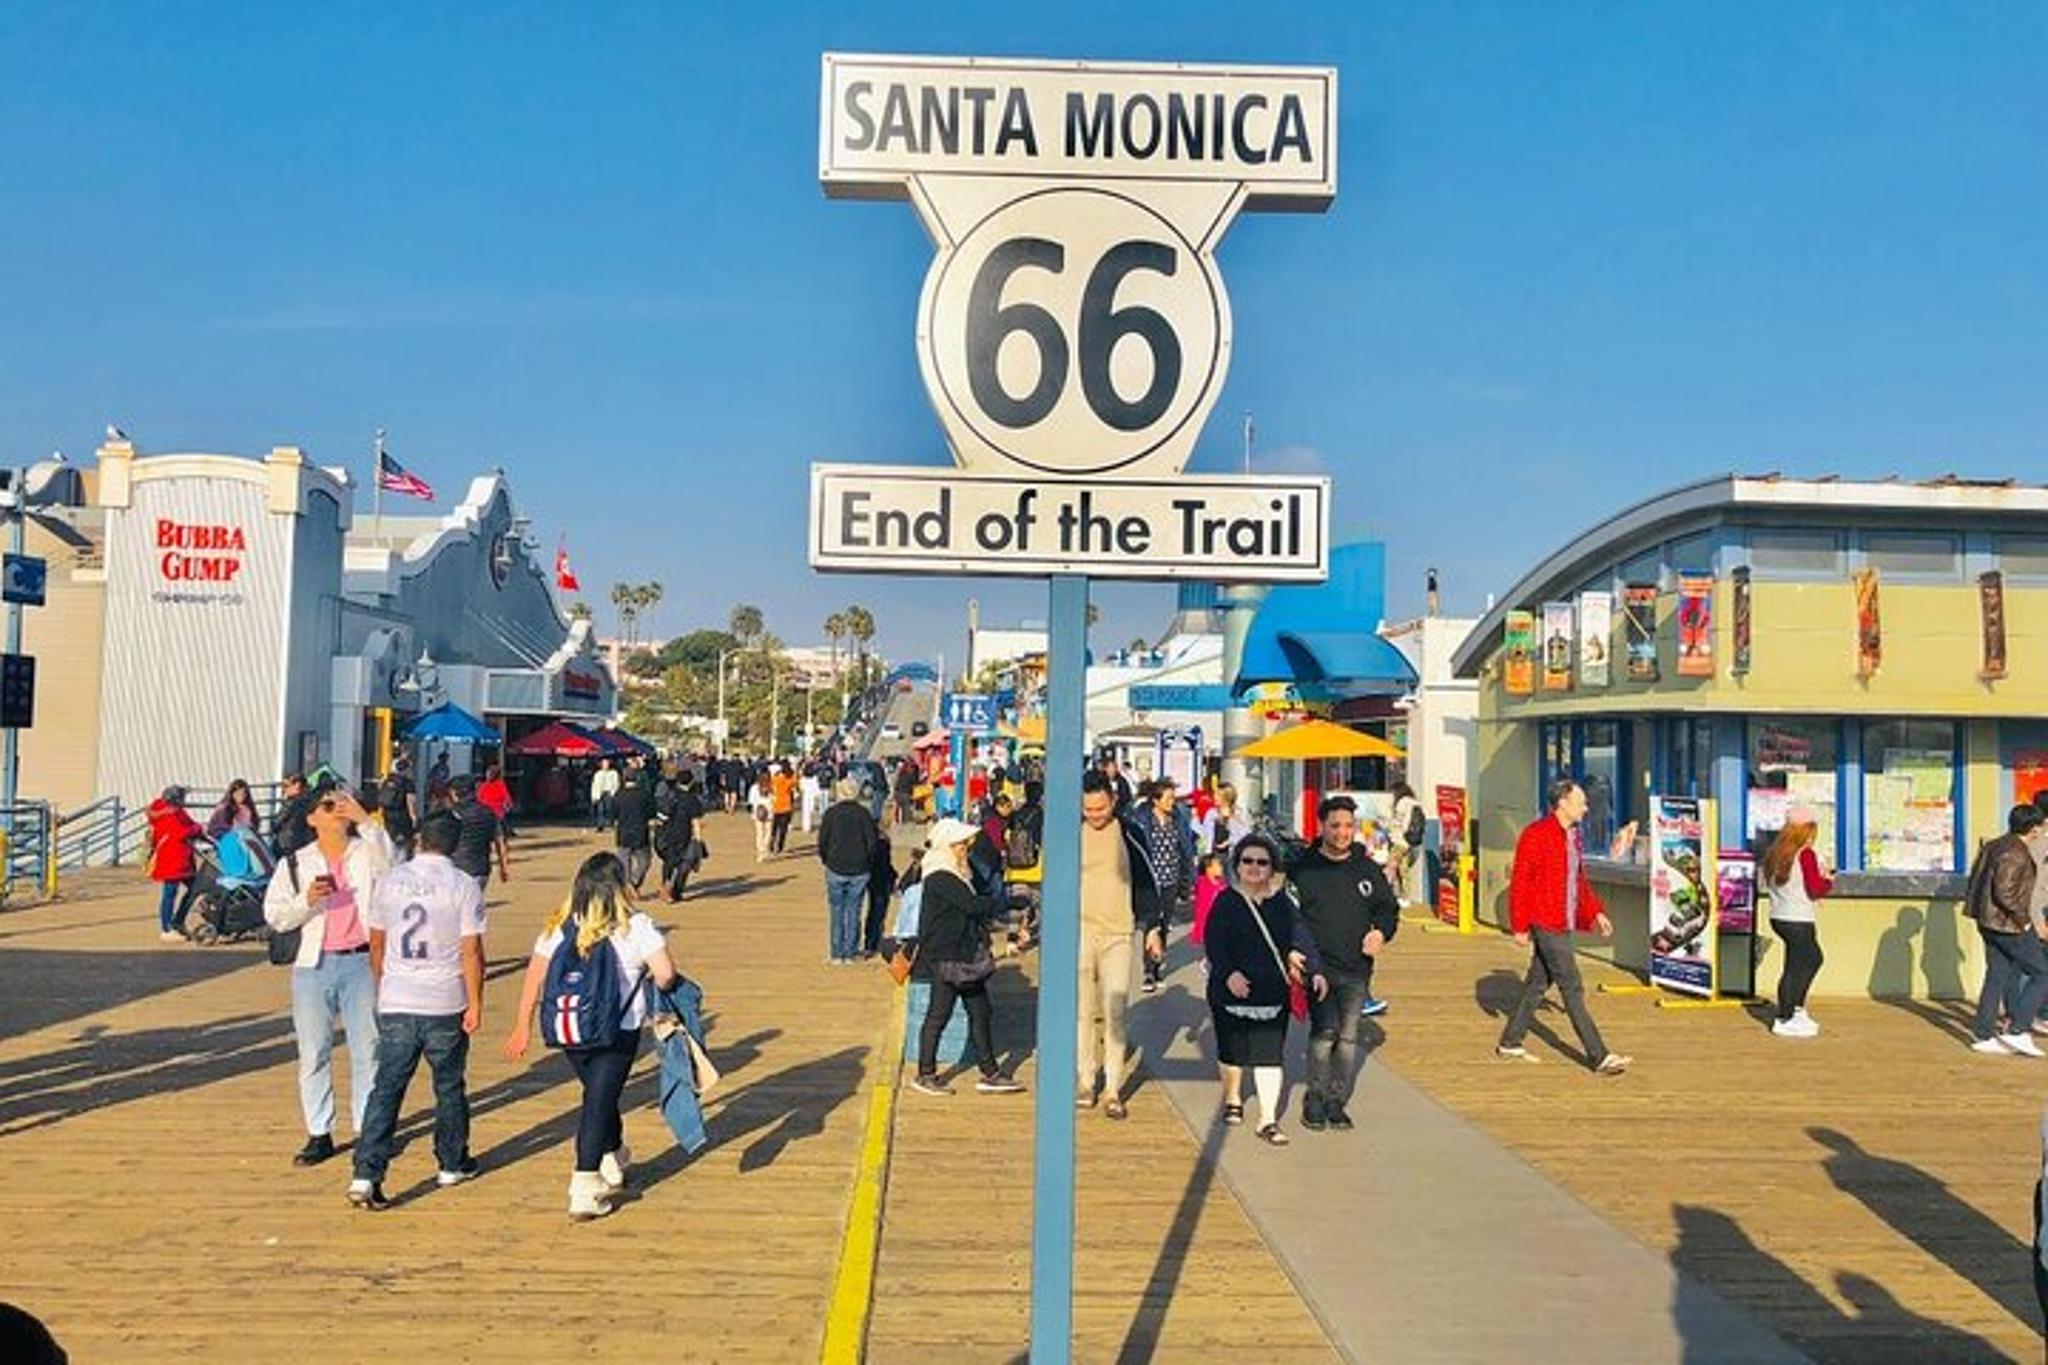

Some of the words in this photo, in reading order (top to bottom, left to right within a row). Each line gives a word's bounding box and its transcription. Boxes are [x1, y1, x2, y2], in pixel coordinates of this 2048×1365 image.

[844, 81, 1038, 157] SANTA
[1064, 91, 1313, 165] MONICA
[966, 237, 1182, 432] 66
[156, 519, 246, 550] BUBBA
[840, 487, 952, 549] End
[975, 489, 1037, 551] of
[1057, 491, 1151, 554] the
[1172, 494, 1300, 556] Trail
[161, 551, 240, 581] GUMP
[401, 903, 427, 959] 2
